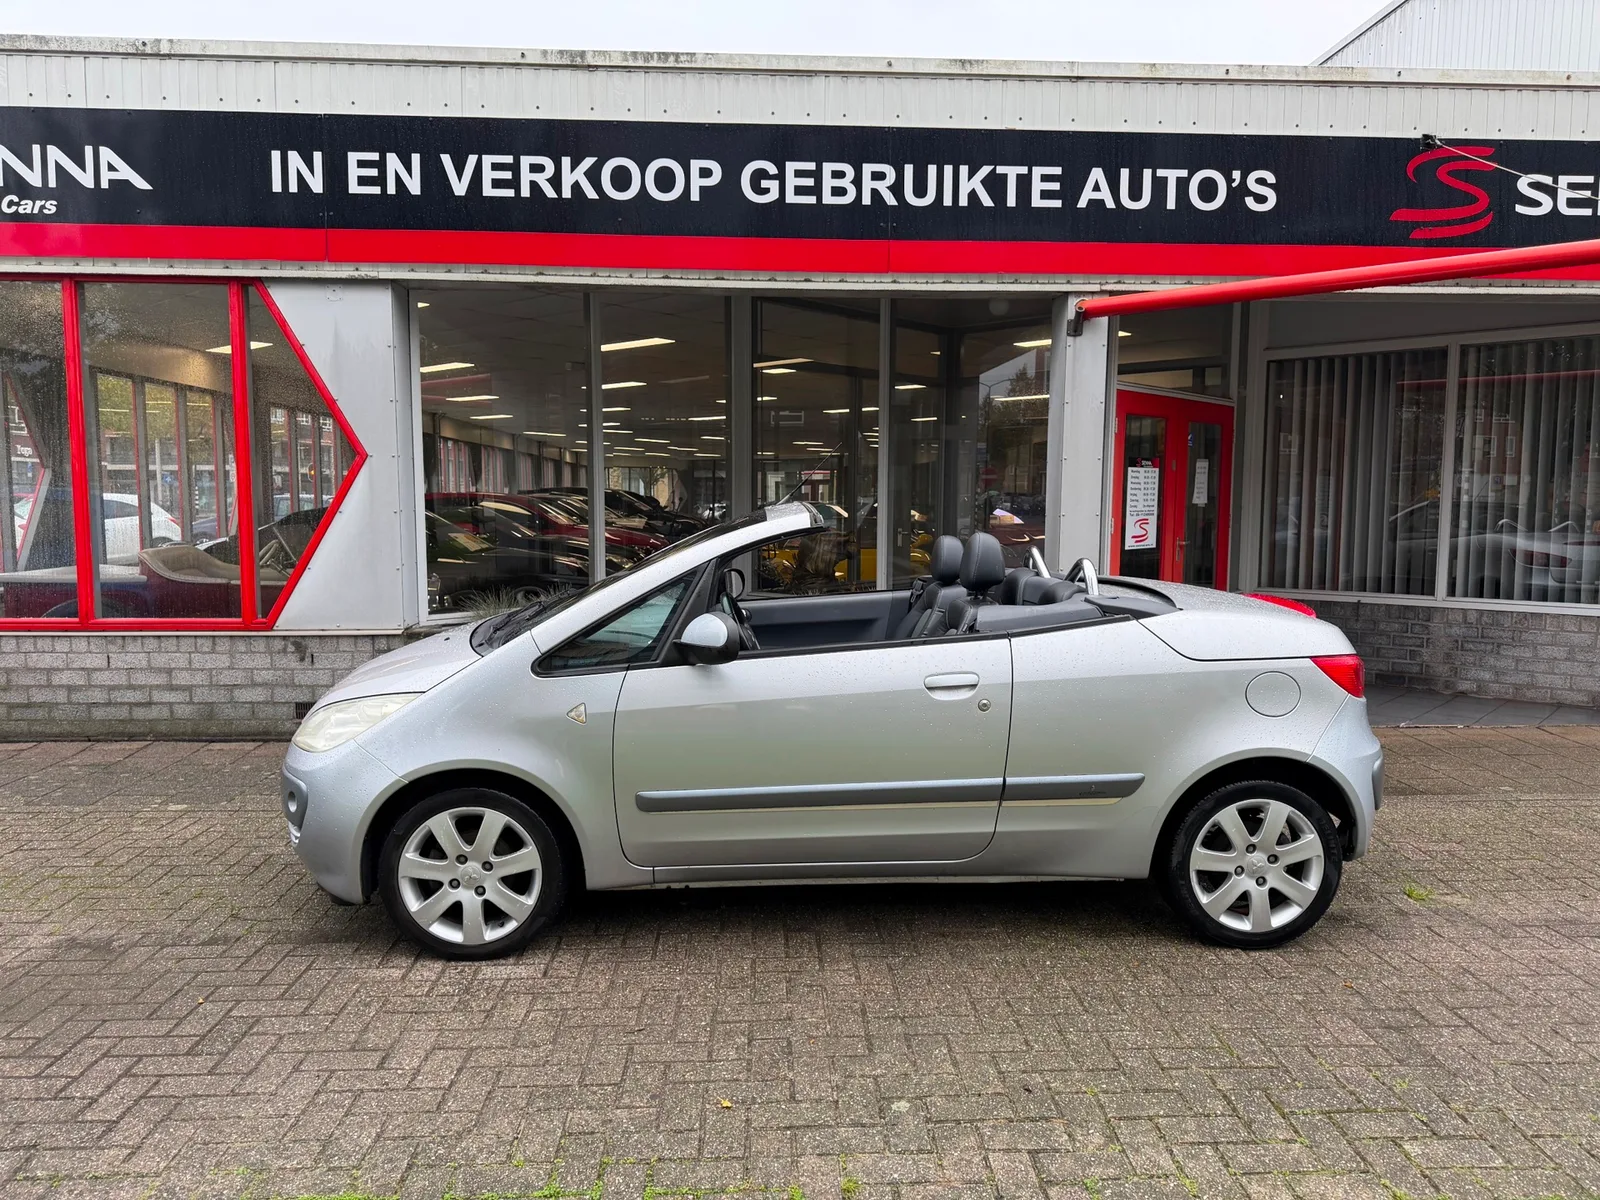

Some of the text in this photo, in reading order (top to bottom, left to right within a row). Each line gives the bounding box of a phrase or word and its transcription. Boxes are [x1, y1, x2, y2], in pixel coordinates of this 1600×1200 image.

[271, 150, 1276, 211] IN EN VERKOOP GEBRUIKTE AUTO’S
[1514, 174, 1600, 216] SE
[1, 195, 57, 214] Cars
